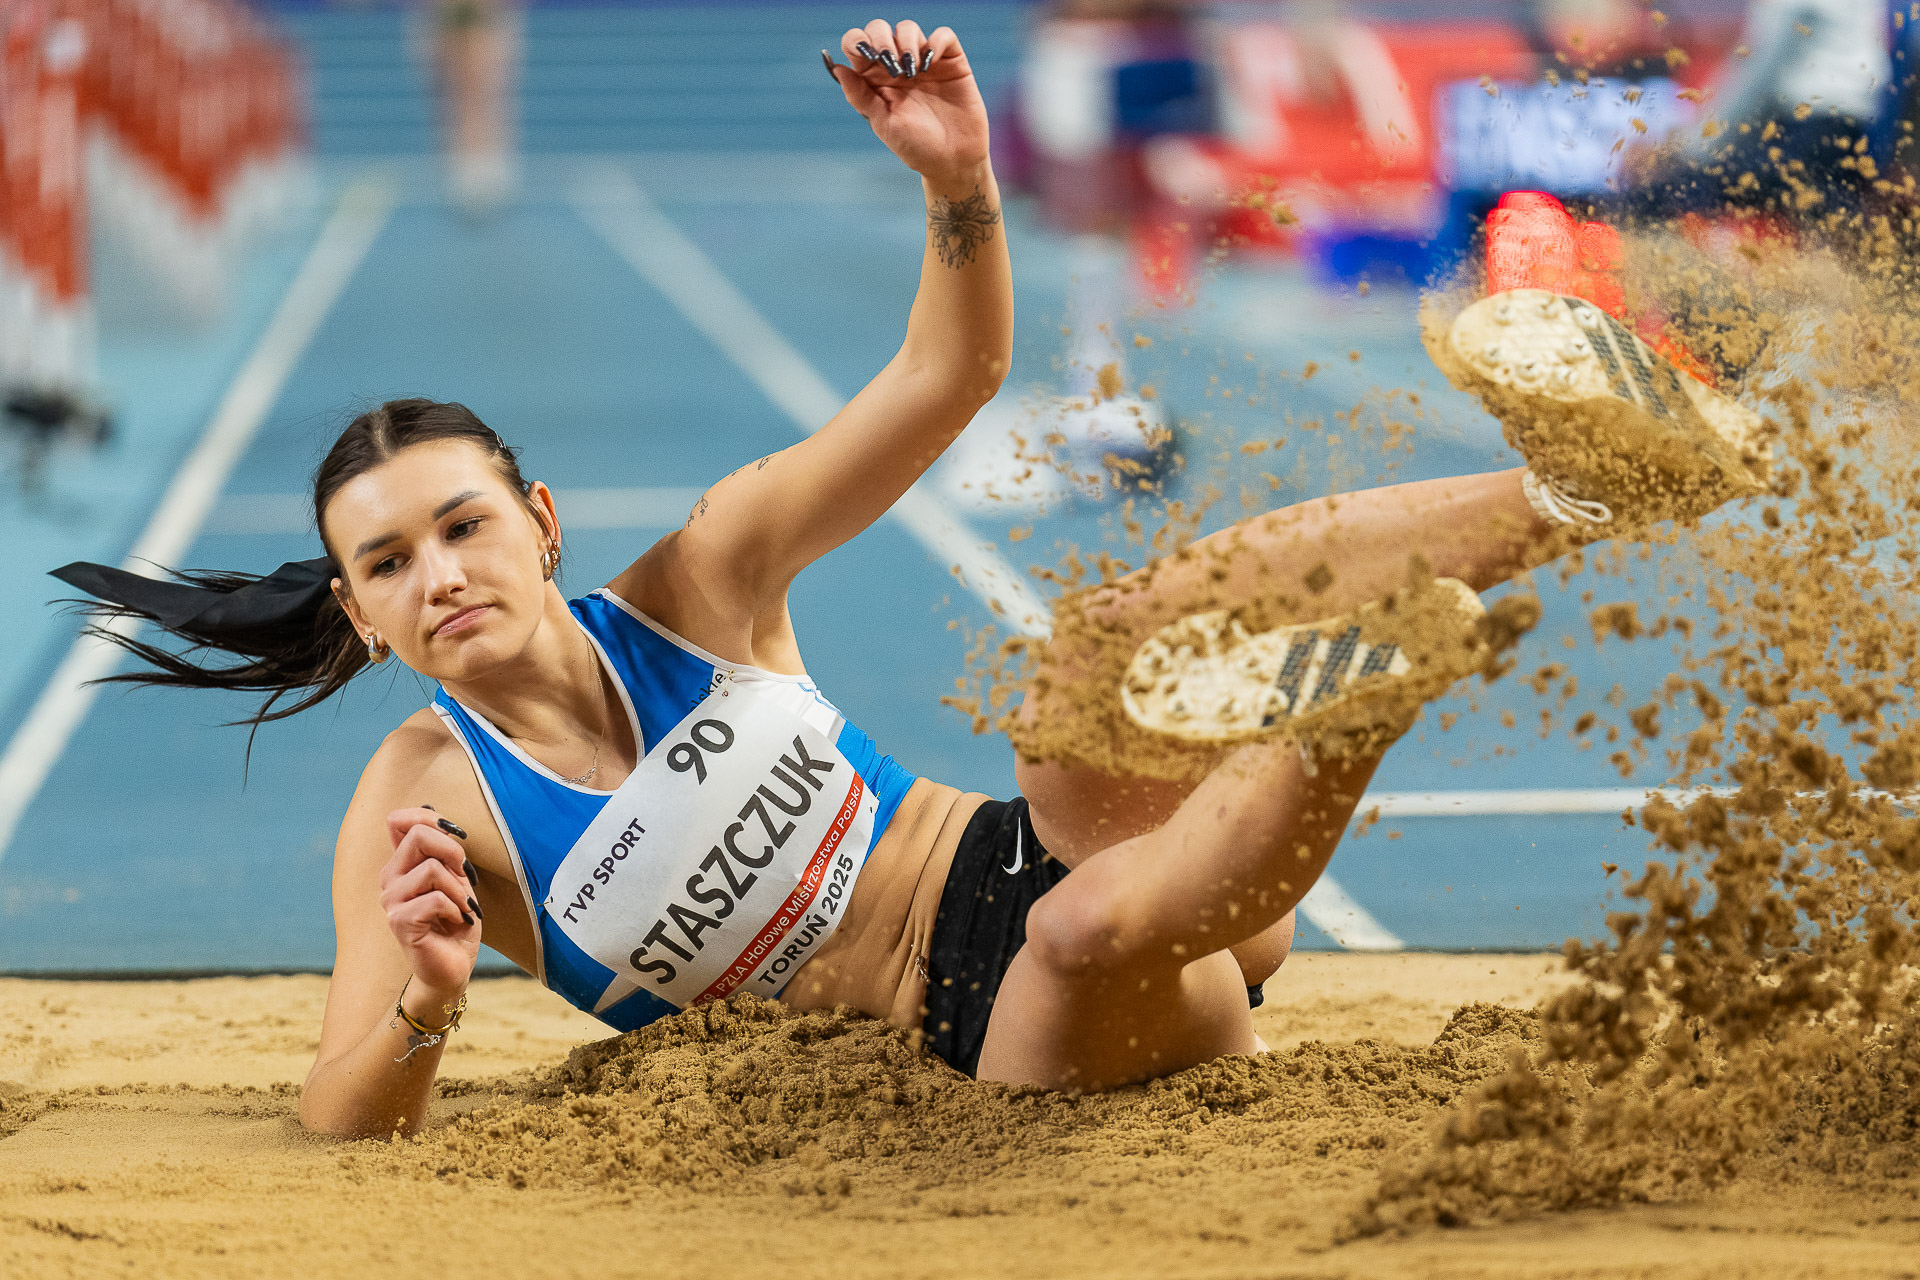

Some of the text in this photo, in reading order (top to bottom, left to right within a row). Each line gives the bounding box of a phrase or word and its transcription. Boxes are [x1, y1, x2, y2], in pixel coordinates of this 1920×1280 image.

[666, 718, 735, 785] 90
[563, 817, 646, 924] TVP SPORT
[629, 734, 835, 985] STASZCZUK
[715, 965, 749, 992] PZLA
[743, 916, 790, 965] Halowe
[785, 829, 840, 916] Mistrzostwa
[837, 783, 861, 830] Polski
[758, 853, 854, 985] TORUŃ 2025
